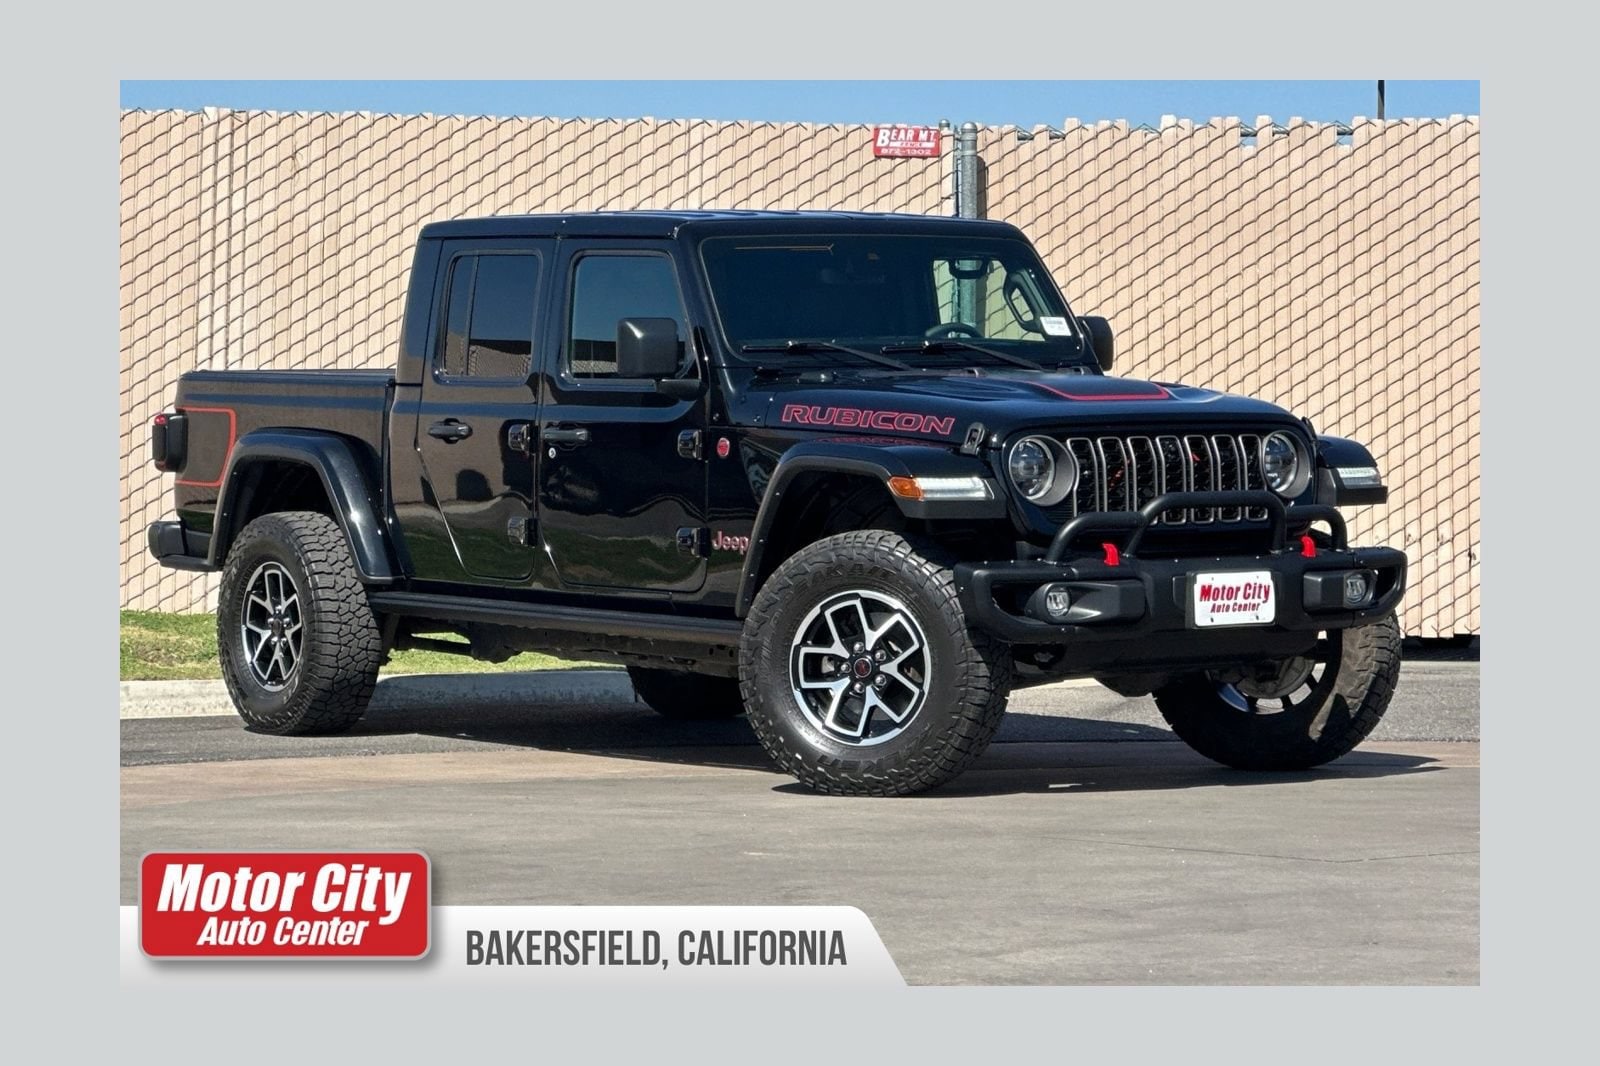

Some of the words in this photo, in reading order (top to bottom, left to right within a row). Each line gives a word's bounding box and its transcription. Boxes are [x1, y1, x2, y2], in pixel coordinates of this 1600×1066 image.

[876, 129, 914, 147] BEAR
[782, 404, 955, 435] RUBICON
[712, 531, 749, 555] Jeep
[1199, 584, 1241, 602] Motor
[1243, 582, 1271, 604] City
[1210, 603, 1230, 613] Auto
[1232, 602, 1261, 613] Center
